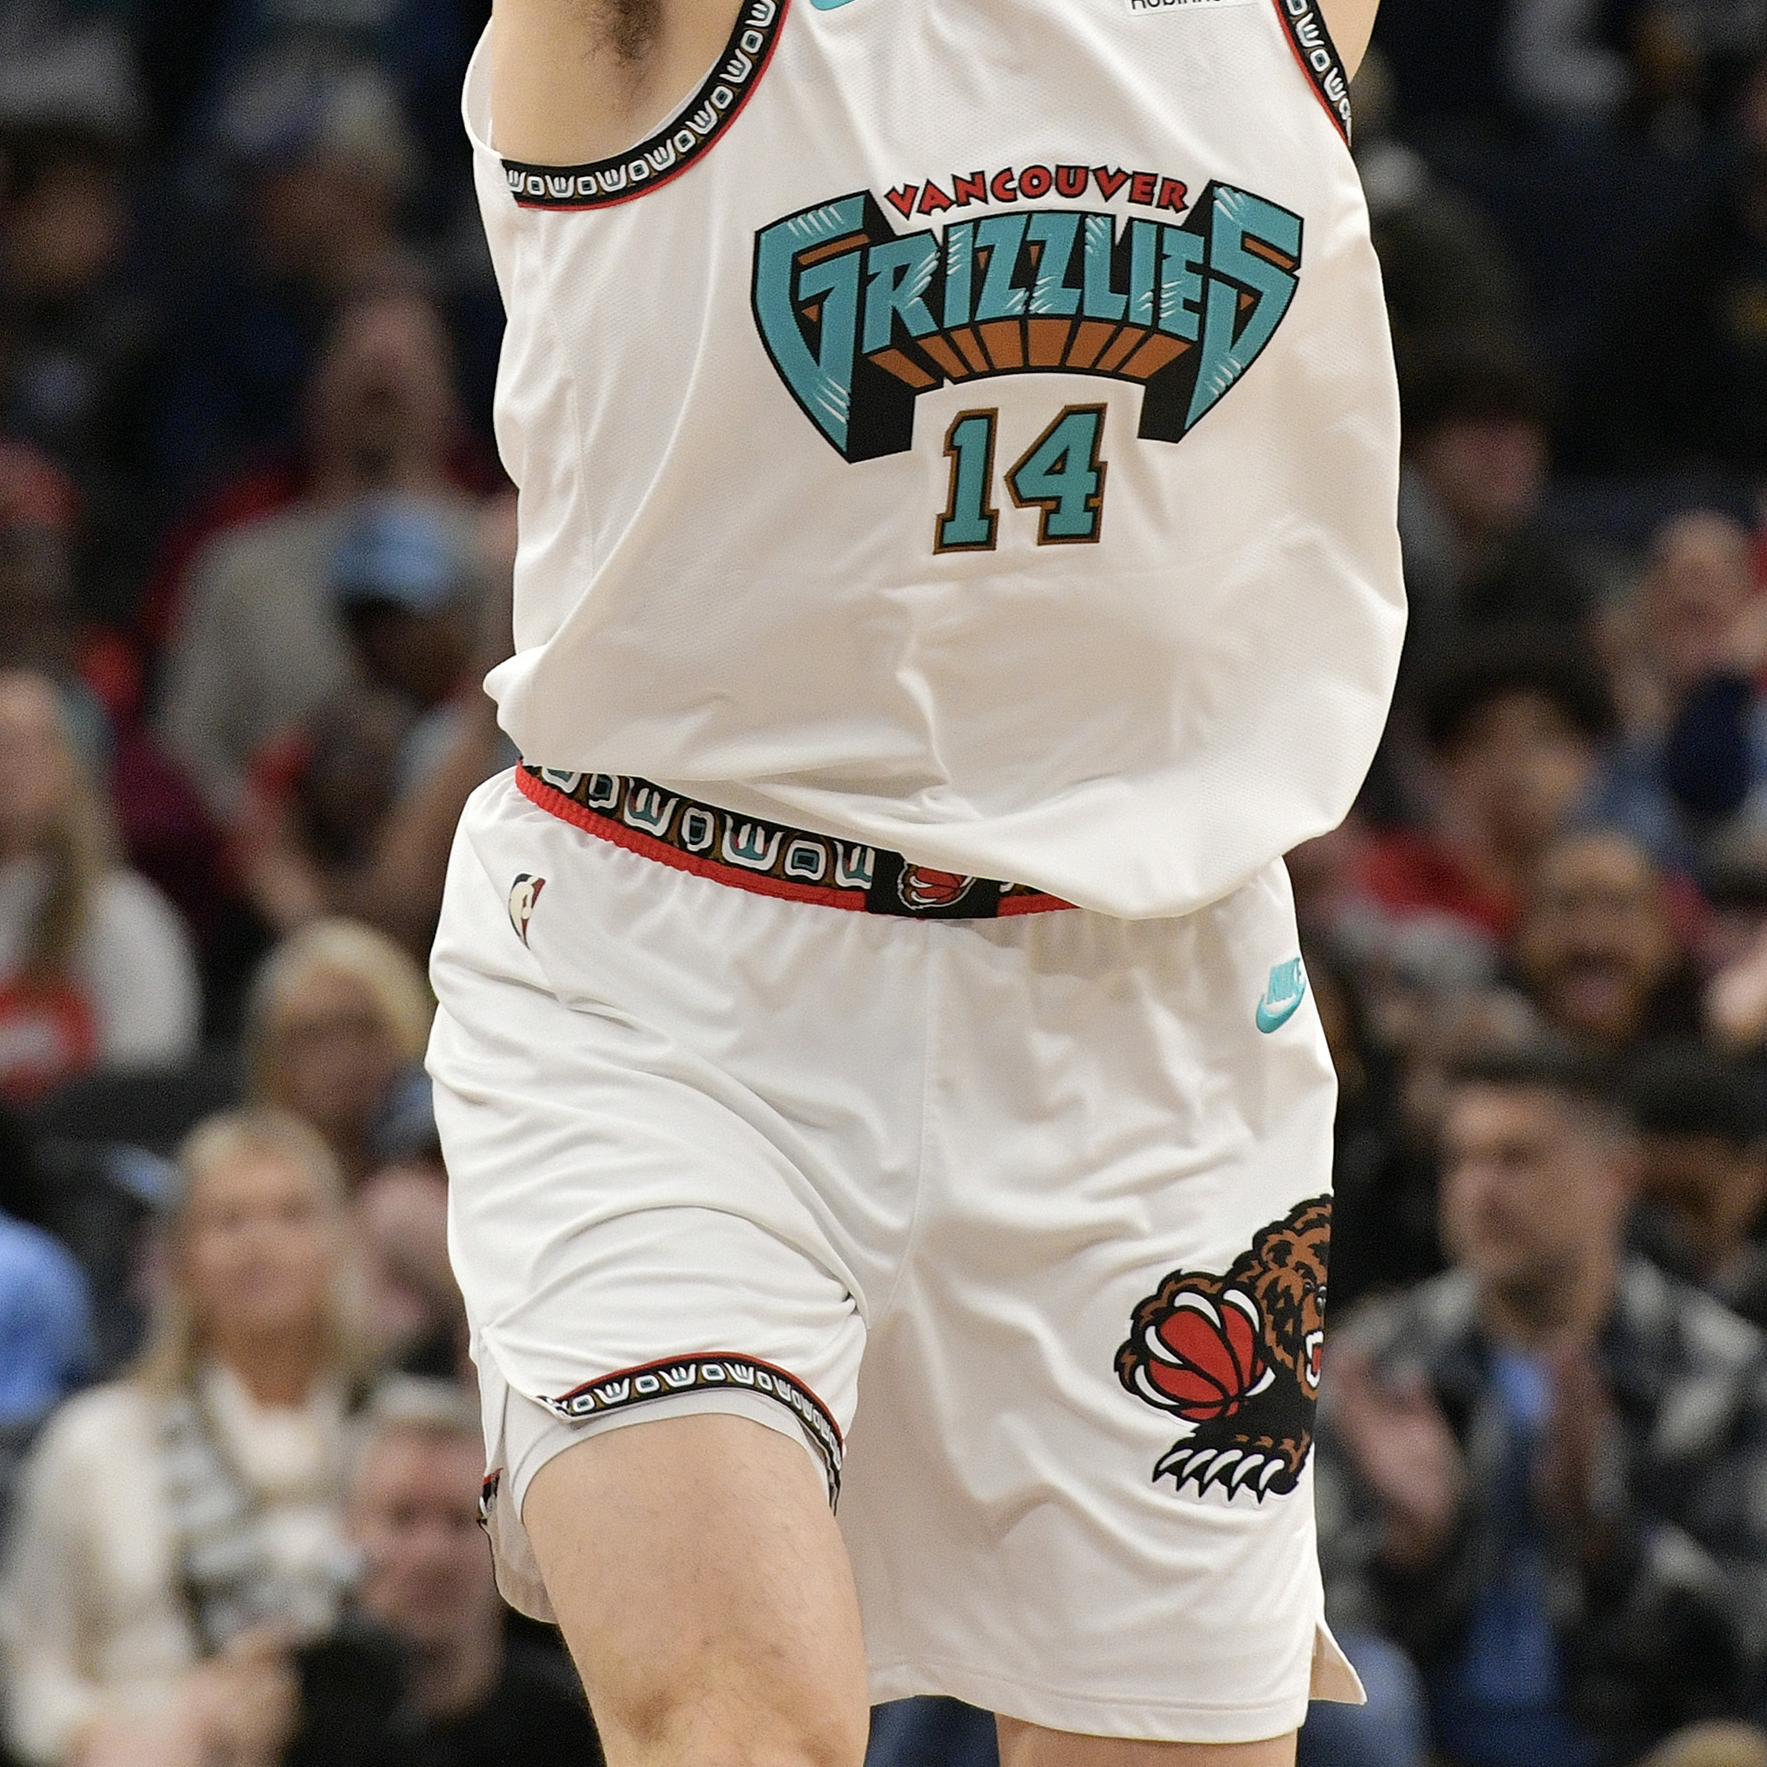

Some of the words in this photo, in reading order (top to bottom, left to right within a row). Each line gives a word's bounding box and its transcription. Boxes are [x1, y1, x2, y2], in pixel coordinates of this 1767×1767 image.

[885, 165, 1189, 218] VANCOUVER
[751, 180, 1304, 464] GRIZZLIES
[934, 403, 1108, 554] 14
